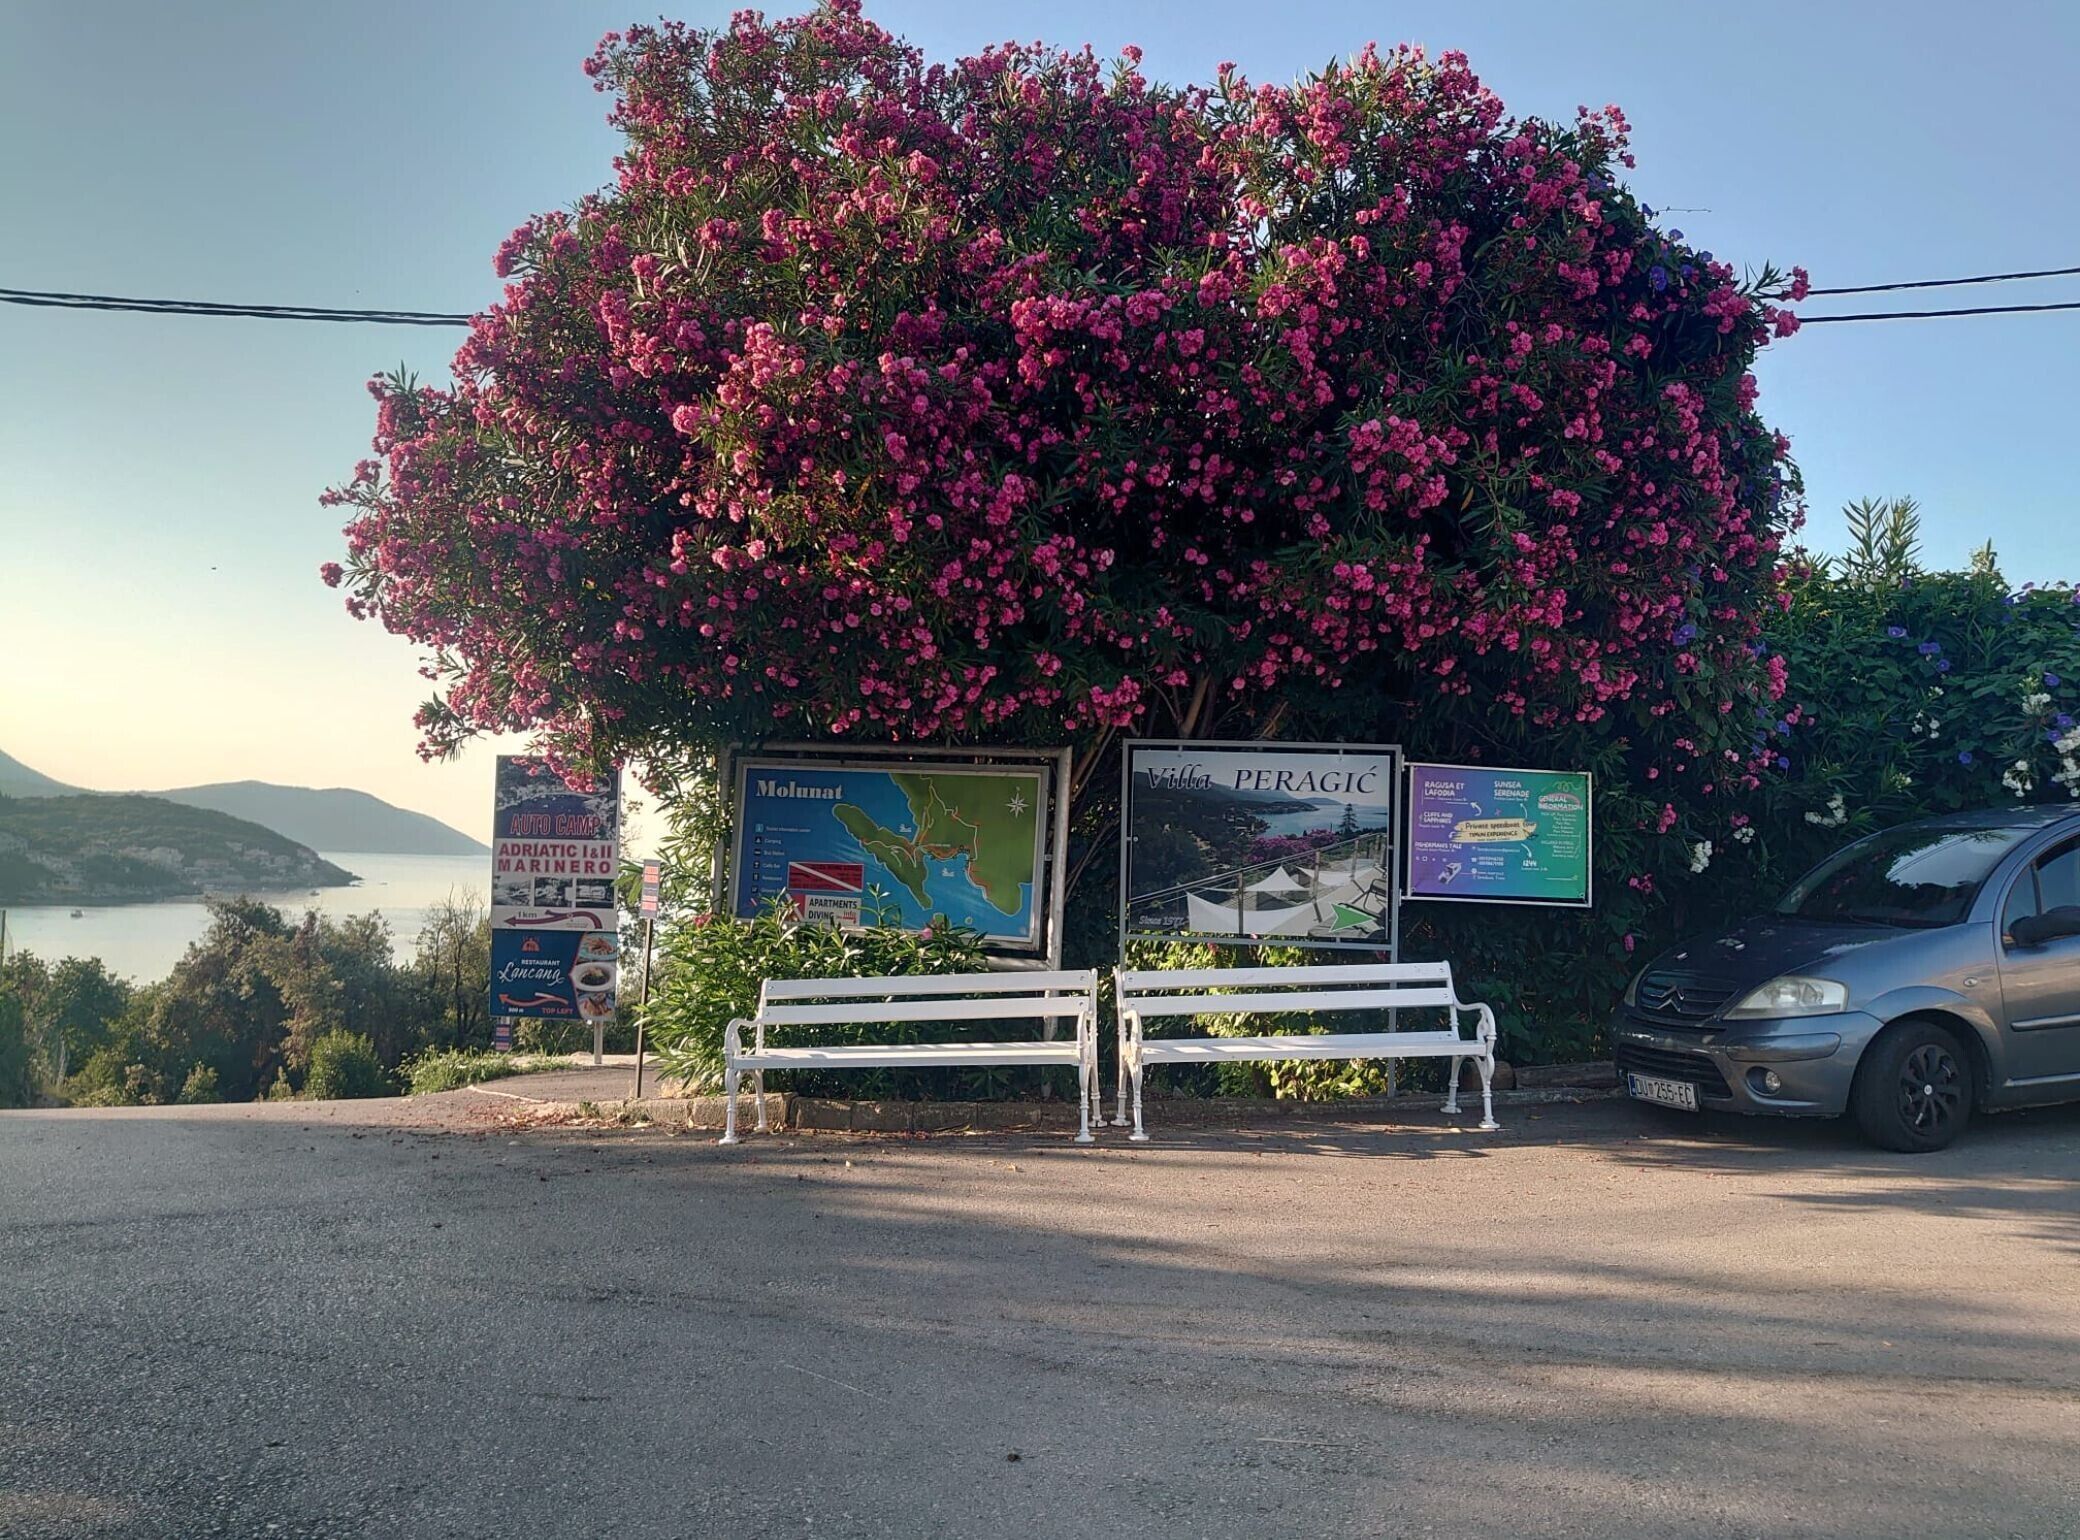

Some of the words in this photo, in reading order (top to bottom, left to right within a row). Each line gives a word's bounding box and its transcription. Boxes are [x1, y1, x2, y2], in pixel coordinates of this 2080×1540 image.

[1148, 763, 1212, 790] Villa
[1234, 765, 1377, 793] PERAGIĆ
[1424, 781, 1454, 790] RAGUSA
[755, 779, 844, 800] Molunat
[1493, 789, 1530, 798] SERENADE
[510, 813, 551, 835] AUTO
[555, 815, 601, 836] CAMP
[498, 842, 577, 859] ADRIATIC
[497, 858, 611, 874] MARINERO
[809, 898, 857, 909] APARTMENTS
[808, 911, 834, 919] DIVING
